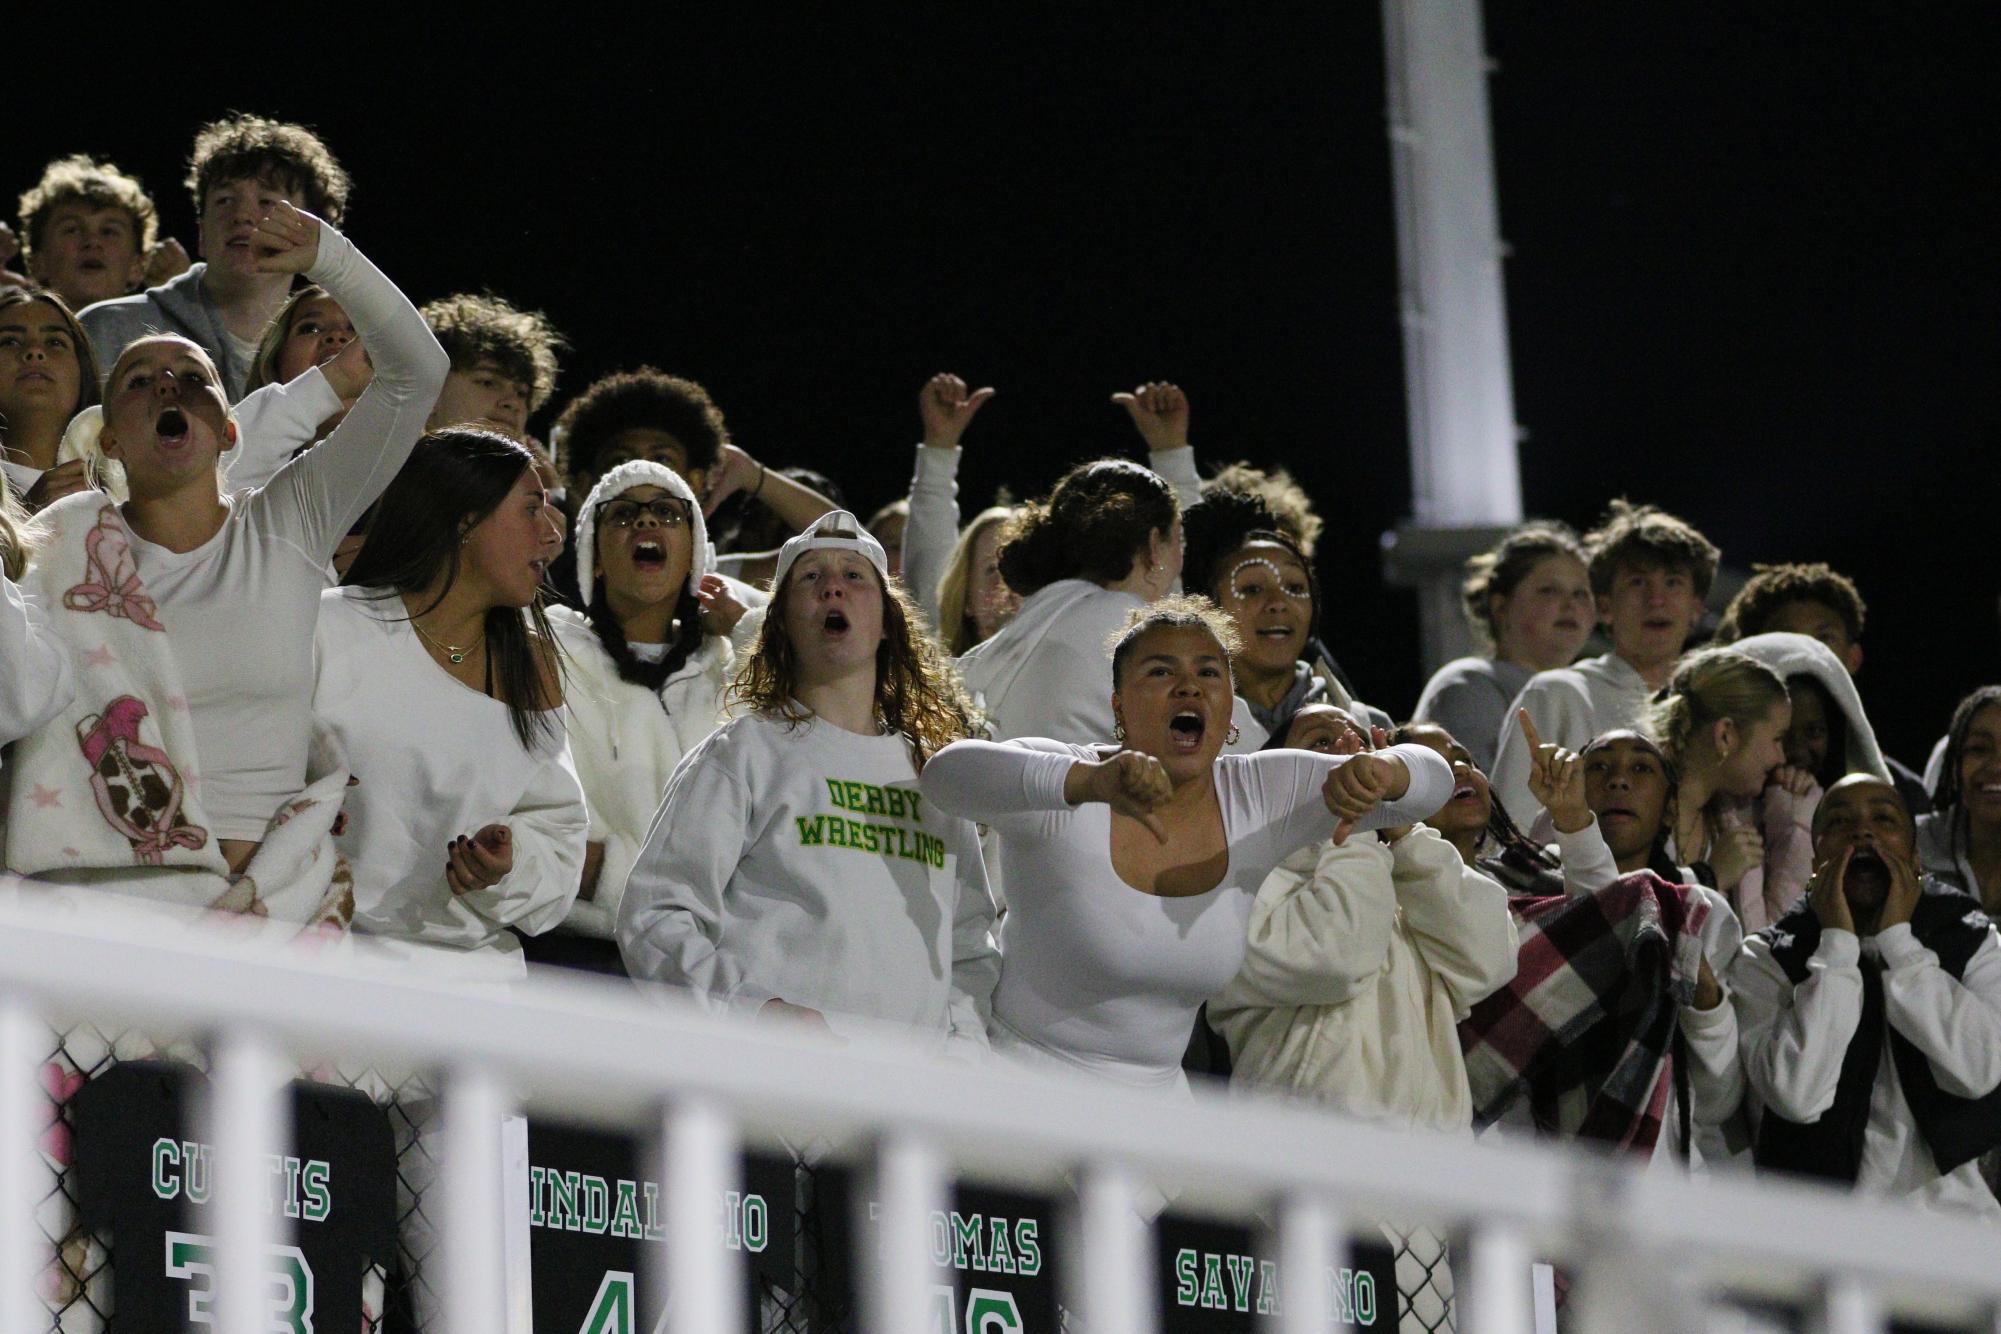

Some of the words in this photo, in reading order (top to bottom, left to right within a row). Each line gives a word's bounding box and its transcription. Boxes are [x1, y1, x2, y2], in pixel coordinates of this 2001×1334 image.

[826, 777, 922, 822] DERBY
[795, 813, 945, 869] WRESTLING
[152, 1137, 331, 1222] CUTIS
[531, 1165, 768, 1252] INDALIO
[869, 1202, 1042, 1276] OMAS
[1176, 1248, 1377, 1326] SAVANO
